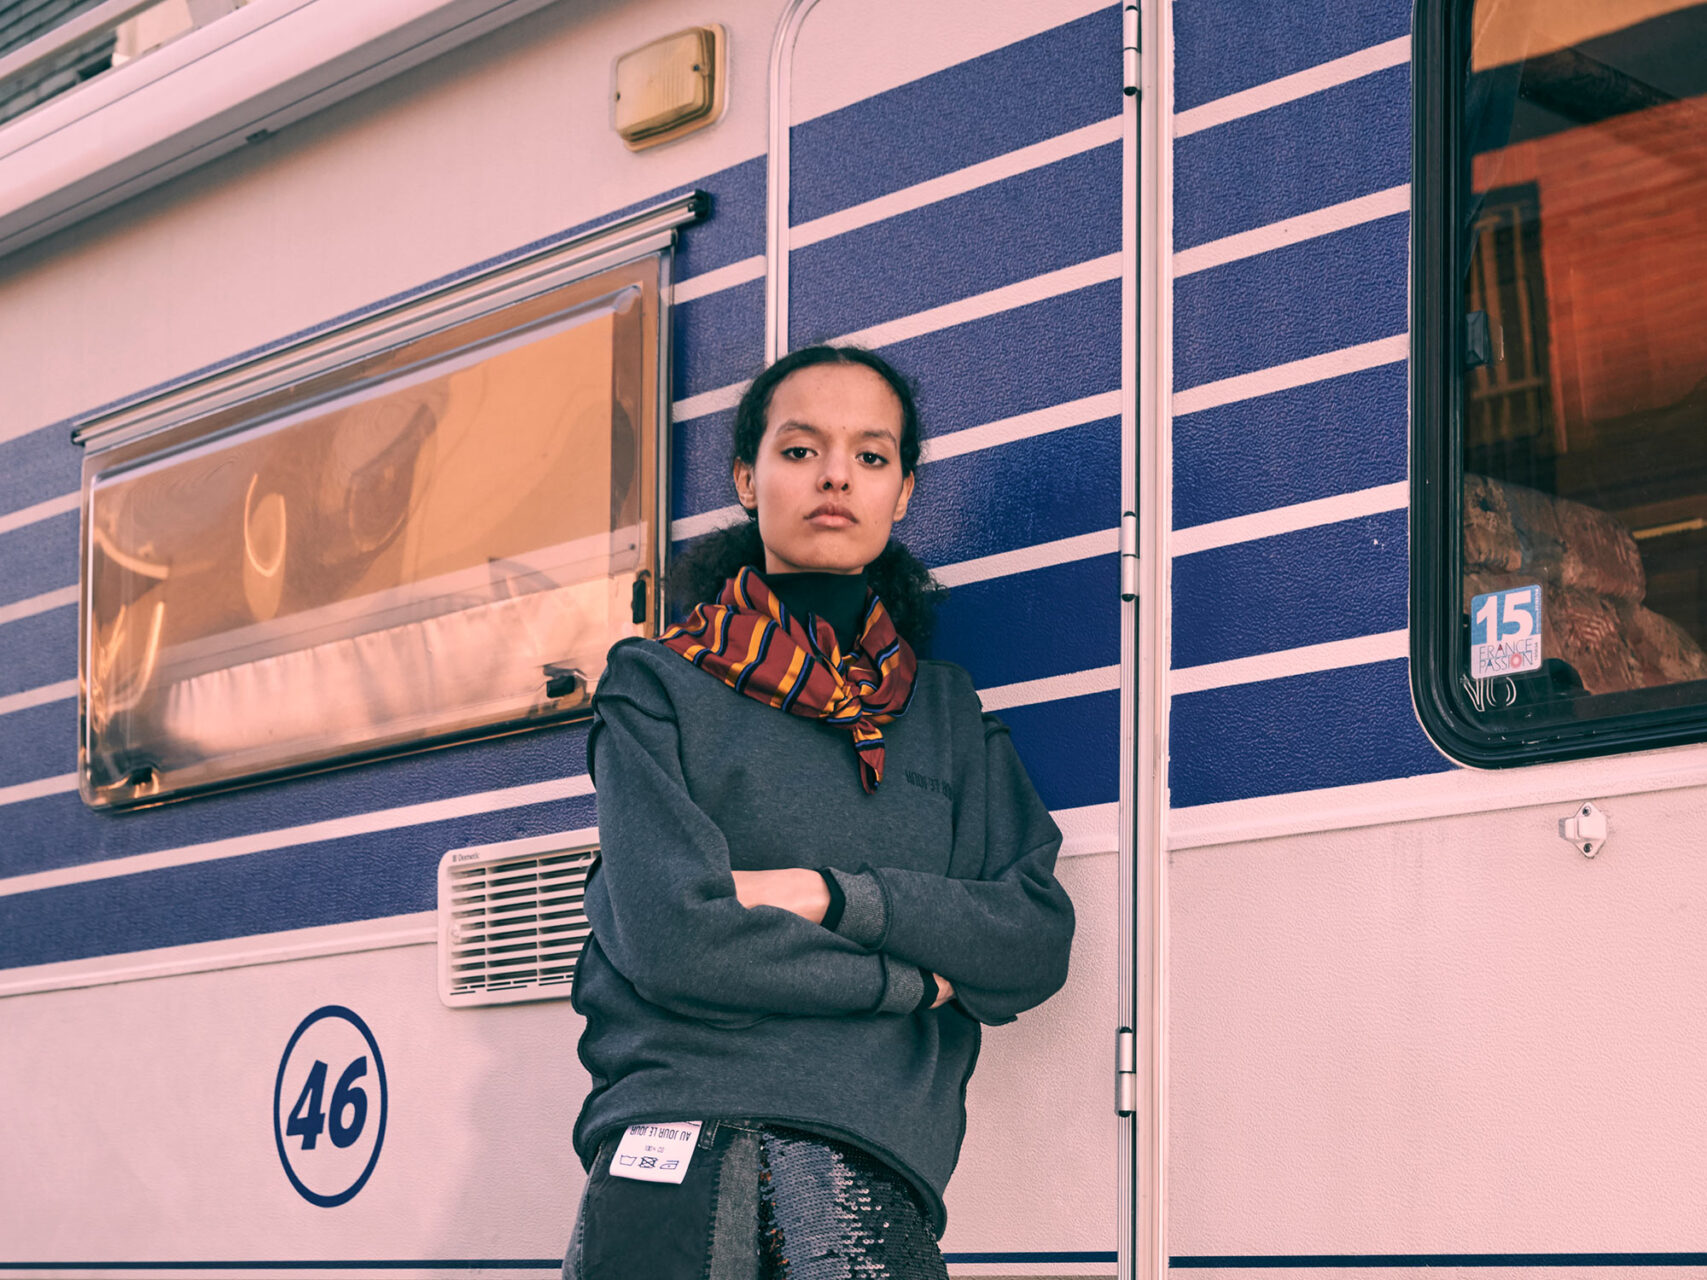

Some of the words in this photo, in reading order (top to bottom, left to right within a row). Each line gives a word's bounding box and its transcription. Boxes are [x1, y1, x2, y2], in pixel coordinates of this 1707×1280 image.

[1477, 590, 1533, 644] 15
[1479, 639, 1533, 660] FRANCE
[1479, 651, 1533, 674] PASSION
[286, 1055, 368, 1151] 46
[630, 1125, 649, 1136] JOUR
[649, 1126, 657, 1137] LE
[658, 1128, 679, 1139] JOUR
[680, 1131, 692, 1141] AU
